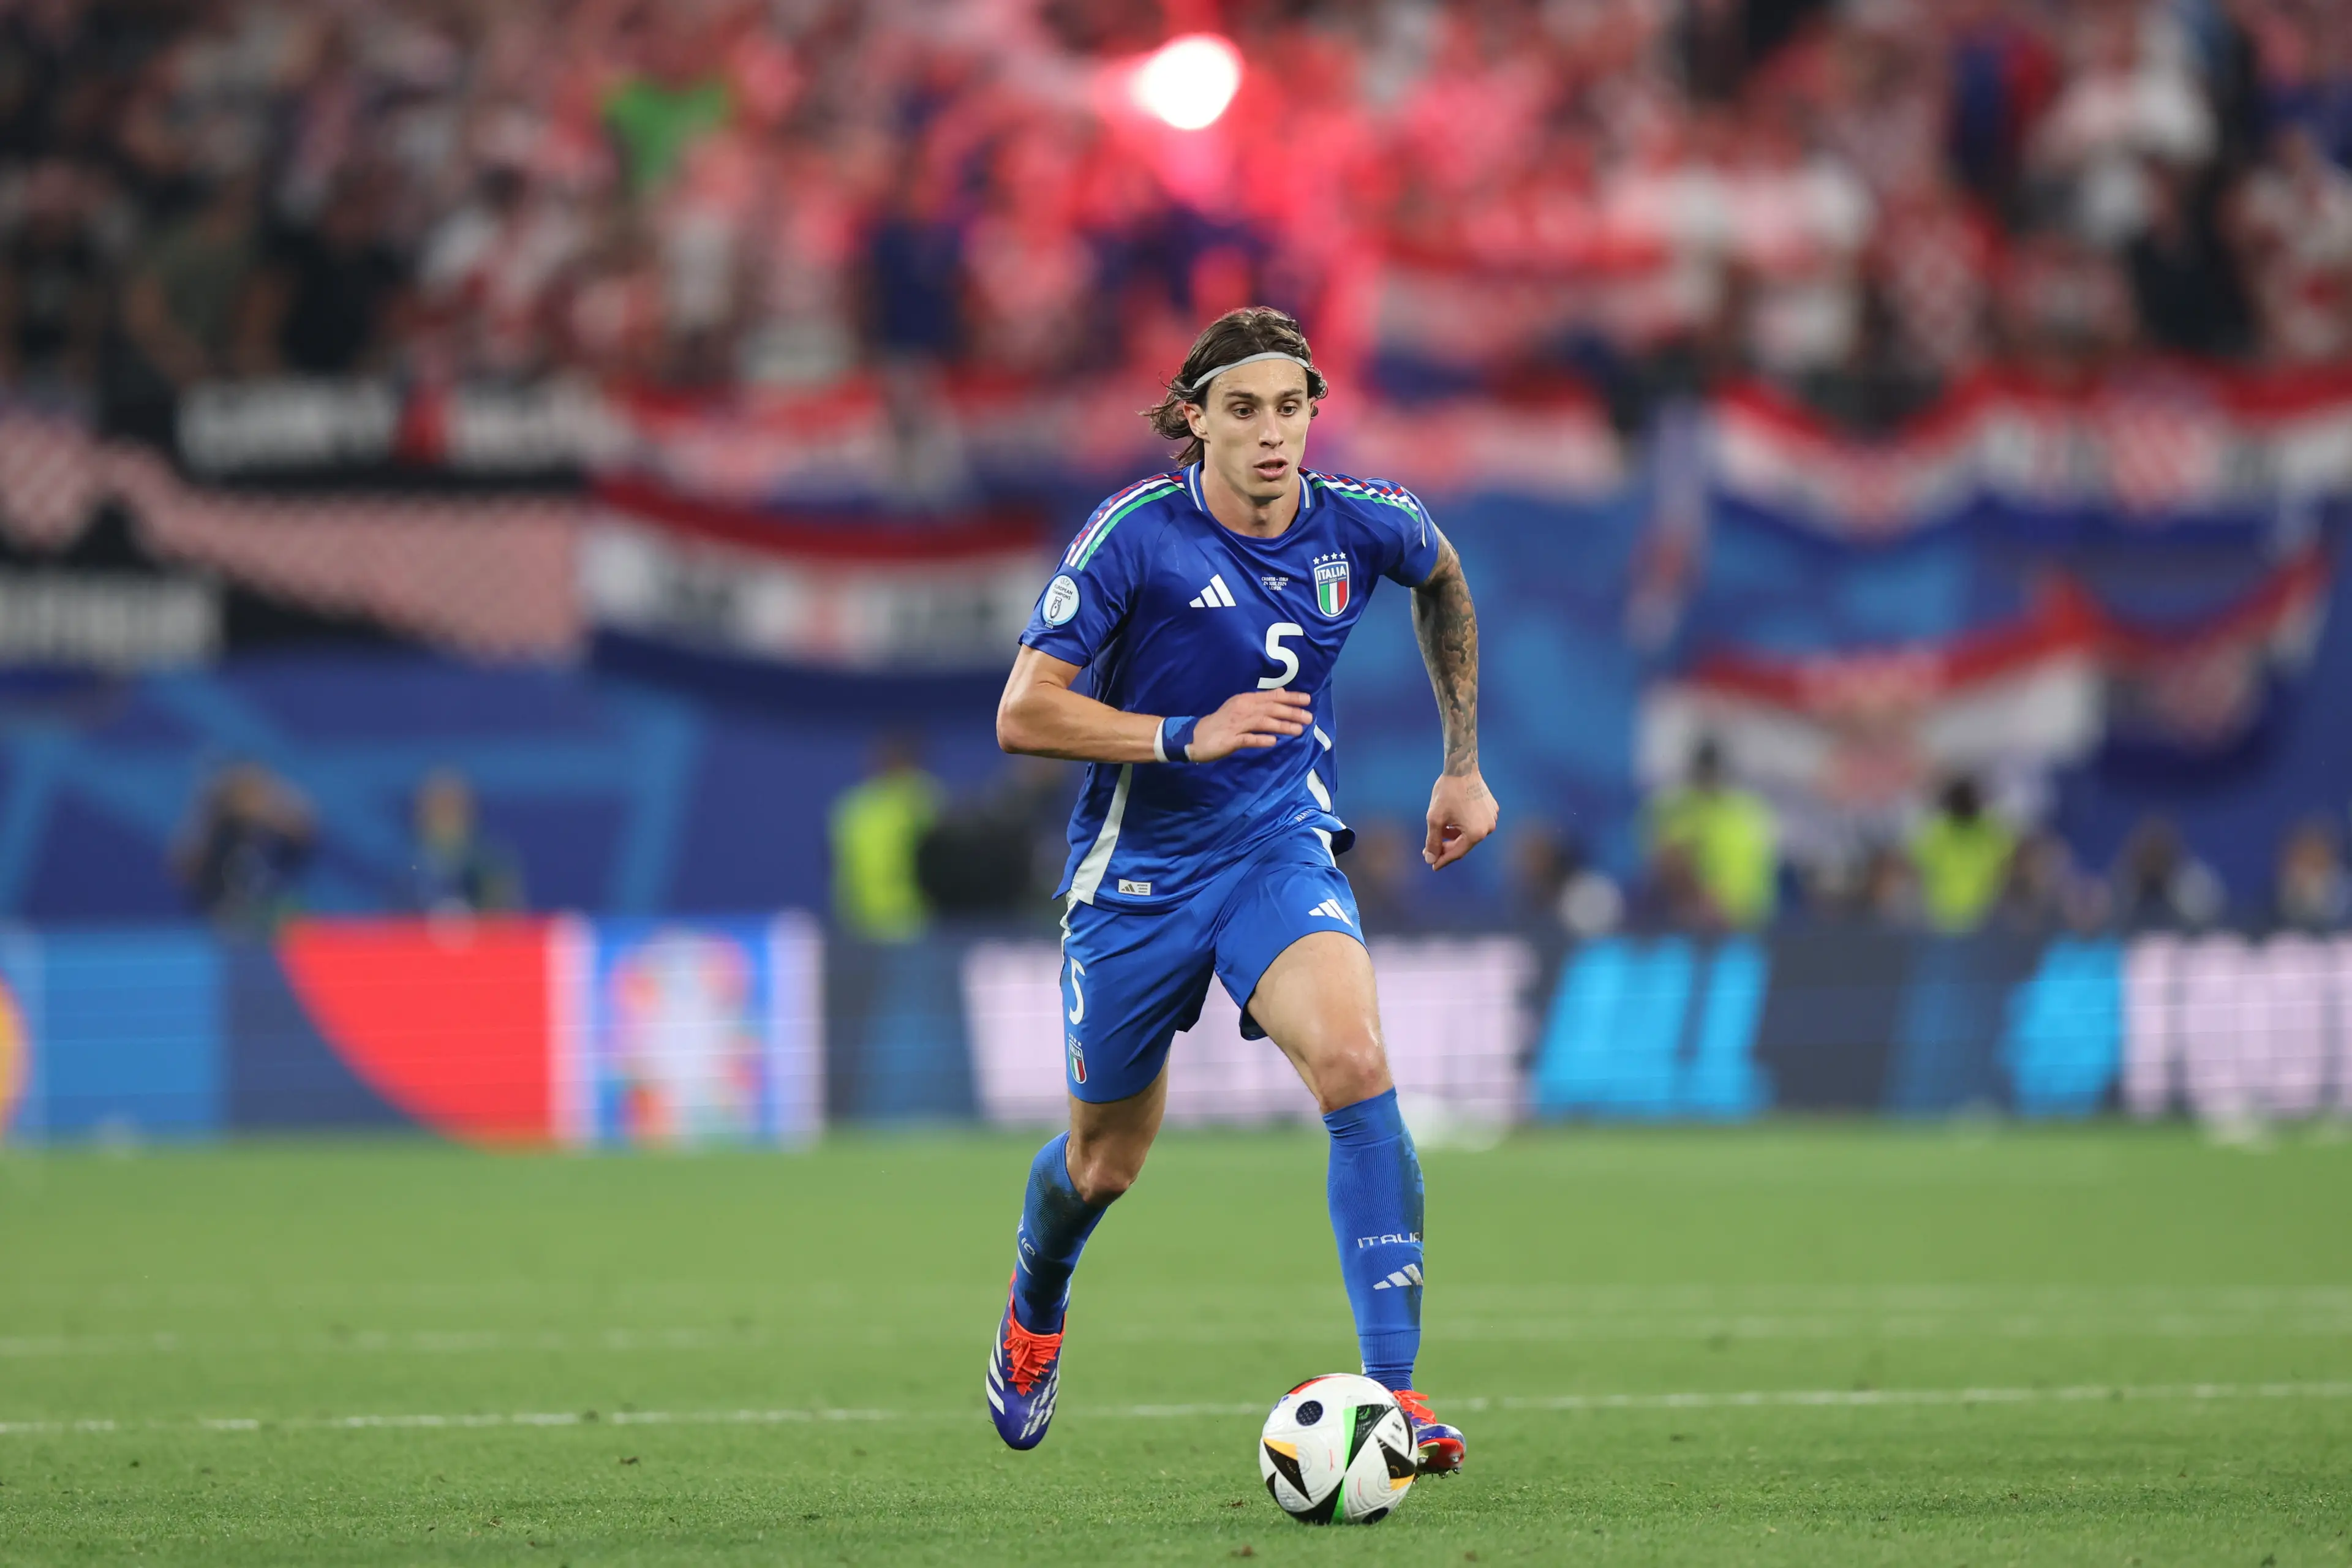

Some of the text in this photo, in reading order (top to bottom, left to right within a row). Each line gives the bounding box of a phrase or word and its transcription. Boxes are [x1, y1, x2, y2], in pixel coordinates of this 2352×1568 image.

[1317, 566, 1346, 581] ITALIA
[1054, 584, 1073, 595] EUROPEAN
[1257, 622, 1304, 689] 5
[1069, 956, 1085, 1025] 5
[1357, 1232, 1420, 1248] ITALIA
